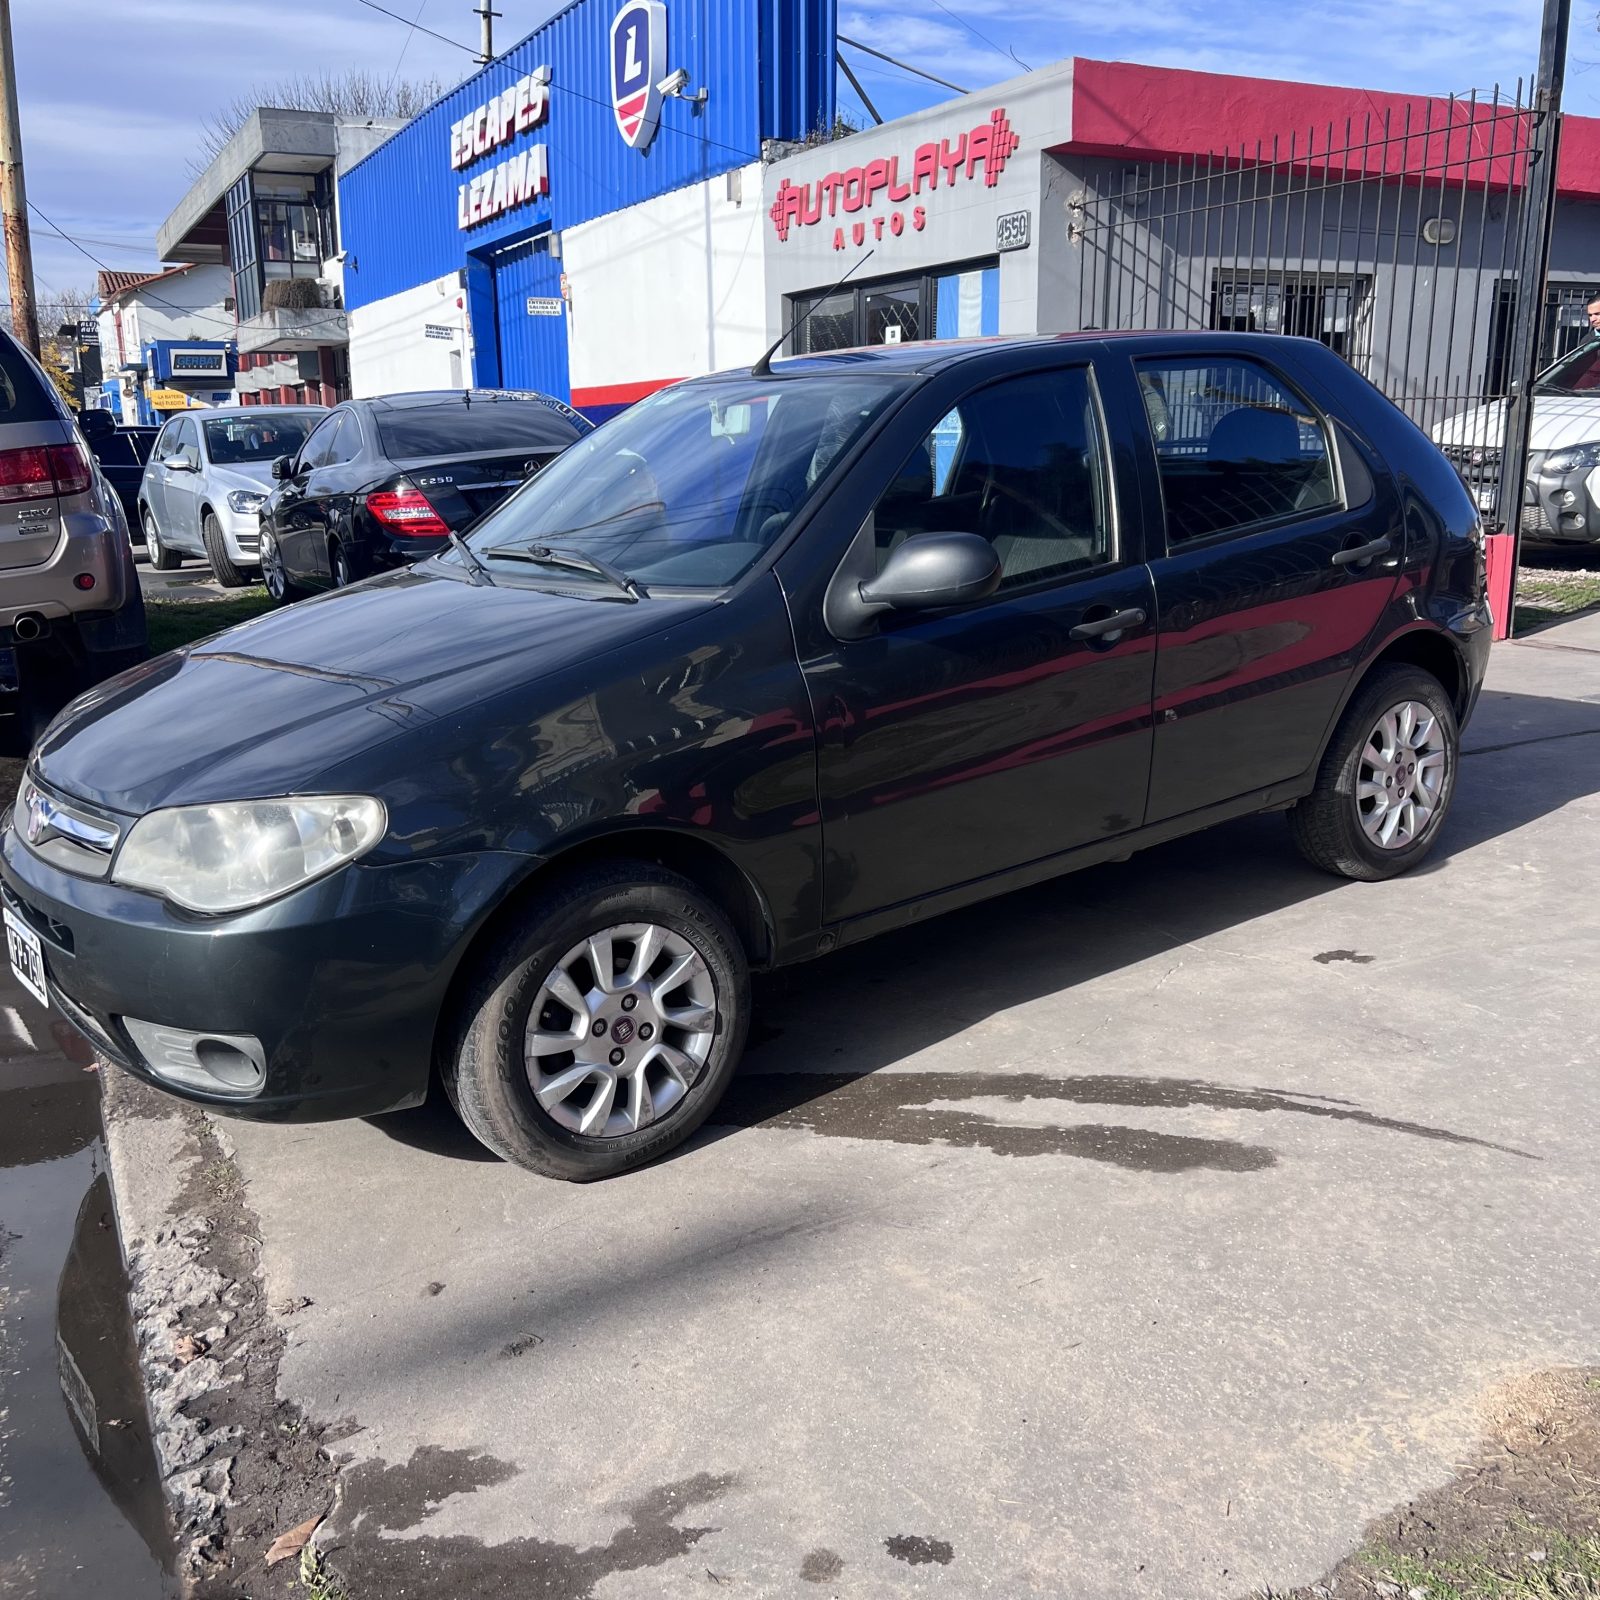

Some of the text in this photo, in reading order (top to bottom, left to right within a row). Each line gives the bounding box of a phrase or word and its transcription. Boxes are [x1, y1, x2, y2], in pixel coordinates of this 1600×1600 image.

[450, 65, 551, 170] ESCAPES
[458, 144, 548, 229] LEZAMA
[782, 124, 995, 227] AUTOPLAYA
[832, 205, 926, 251] AUTOS
[997, 214, 1026, 242] 4550
[177, 356, 219, 365] GERBAT
[420, 476, 453, 486] C 250
